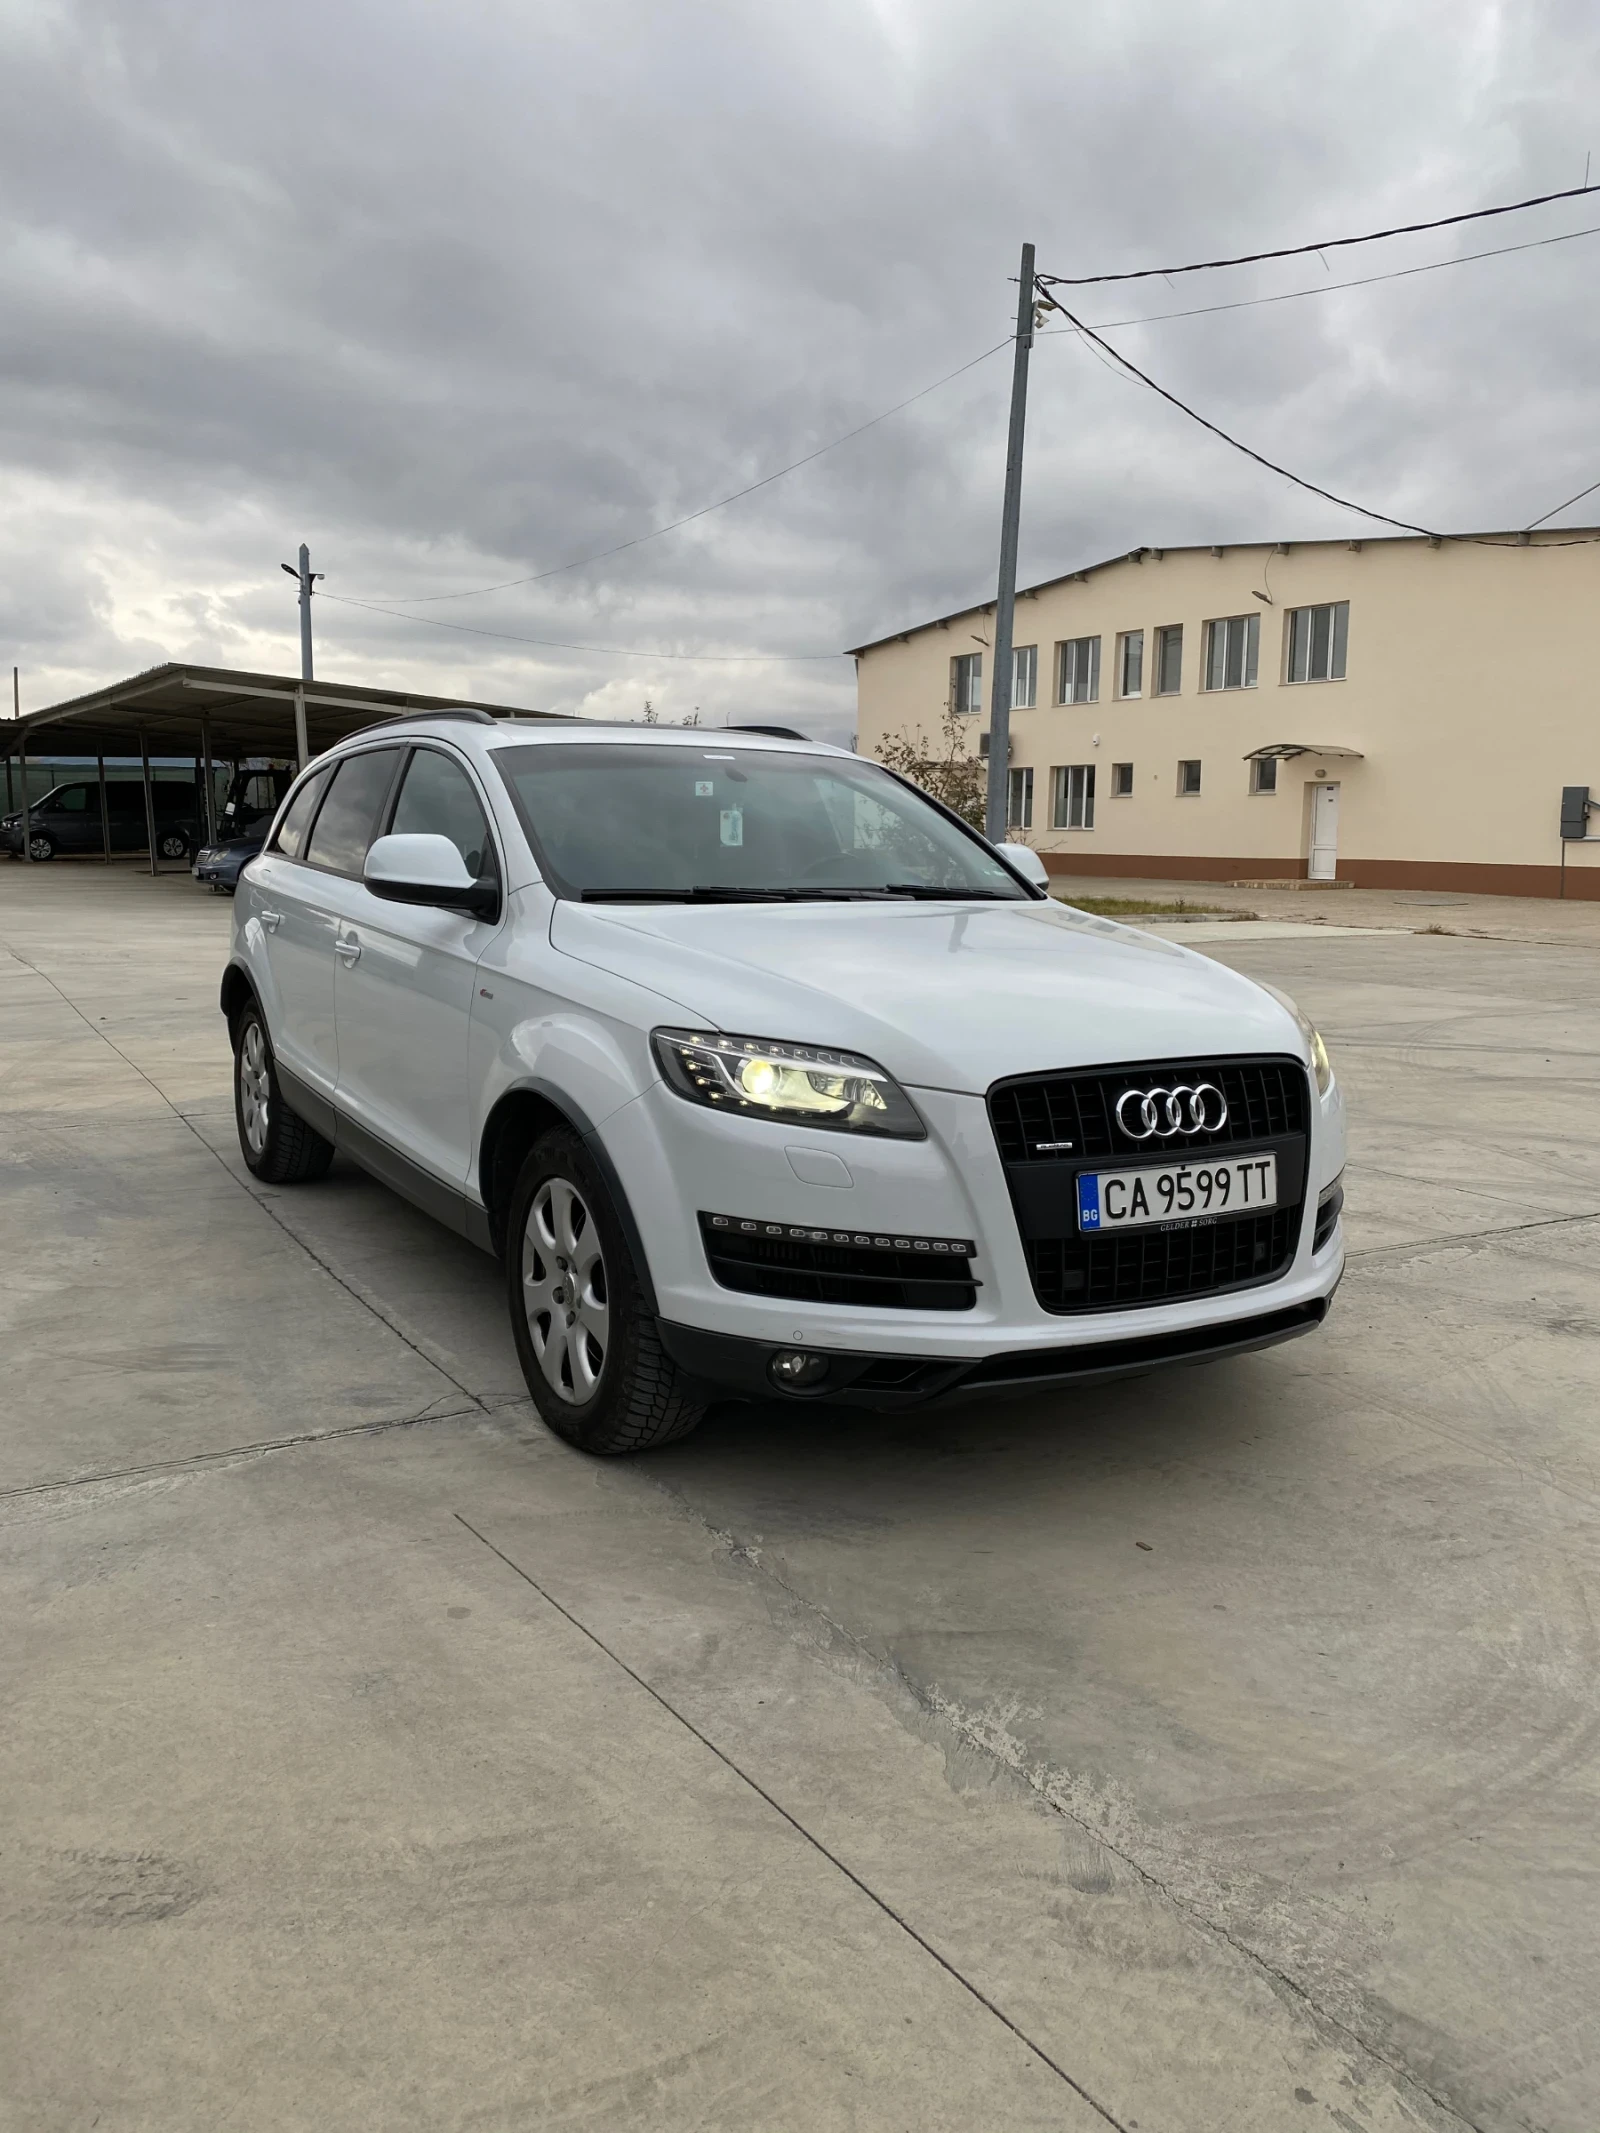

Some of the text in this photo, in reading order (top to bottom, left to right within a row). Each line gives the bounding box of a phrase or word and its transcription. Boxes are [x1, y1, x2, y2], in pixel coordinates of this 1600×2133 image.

[1105, 1161, 1271, 1219] CA 9599 TT
[1083, 1210, 1098, 1221] BG
